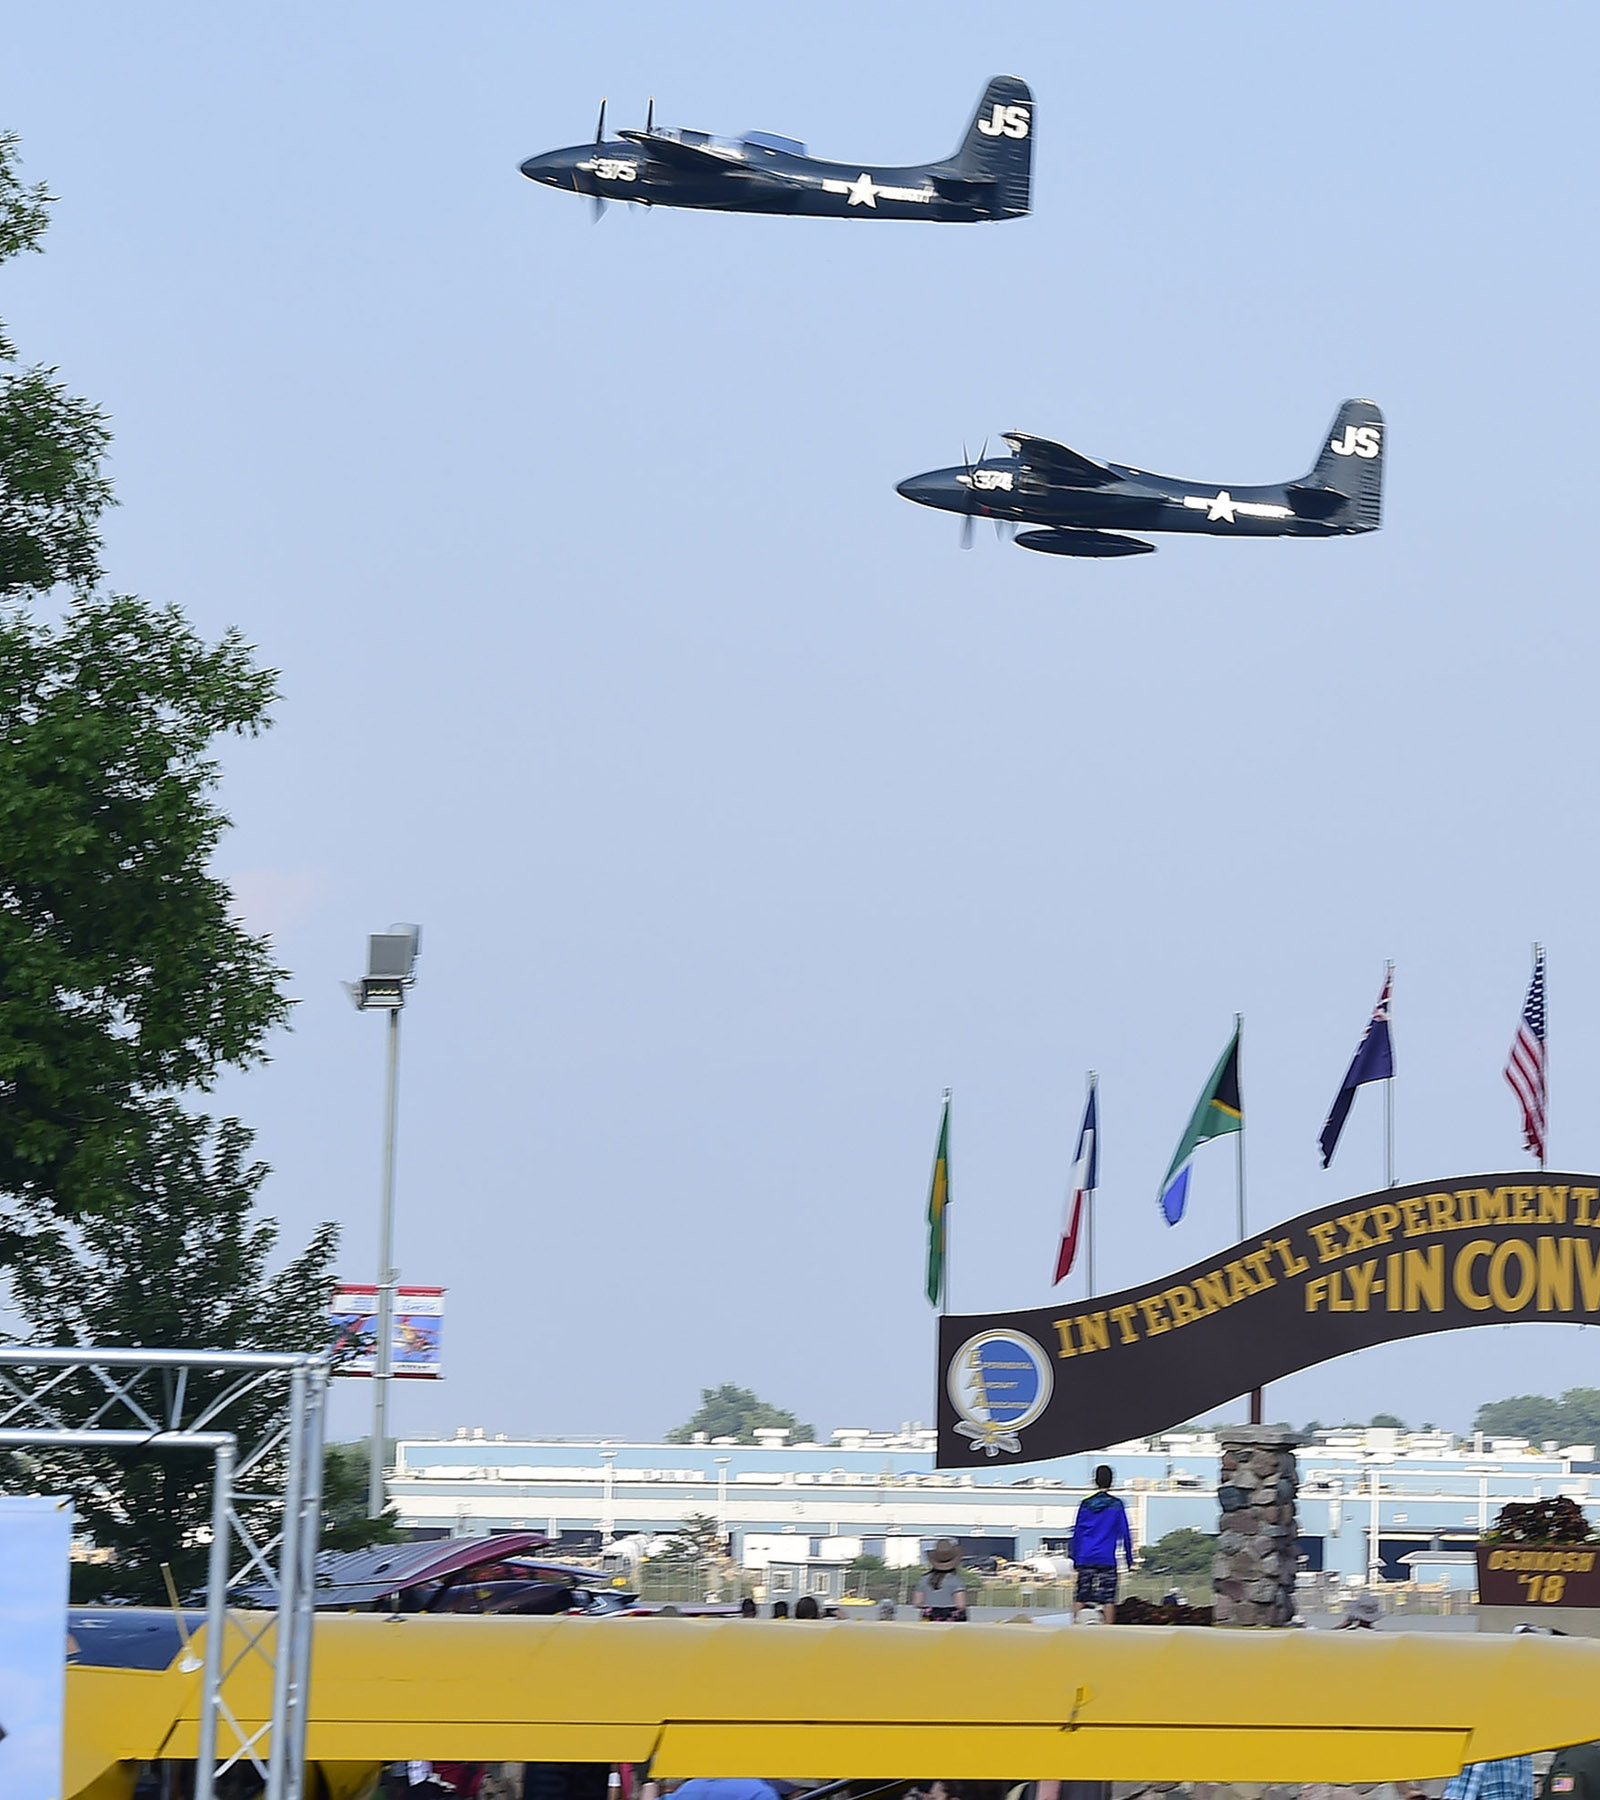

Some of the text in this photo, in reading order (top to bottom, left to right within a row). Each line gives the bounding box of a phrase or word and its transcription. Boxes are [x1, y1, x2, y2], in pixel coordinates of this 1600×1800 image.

[978, 104, 1030, 139] JS
[1330, 425, 1381, 459] JS
[1305, 1244, 1445, 1313] FLY-IN
[1052, 1237, 1310, 1358] INTERNAT'L
[1487, 1549, 1597, 1573] OSHKOSH
[1517, 1574, 1567, 1604] '18
